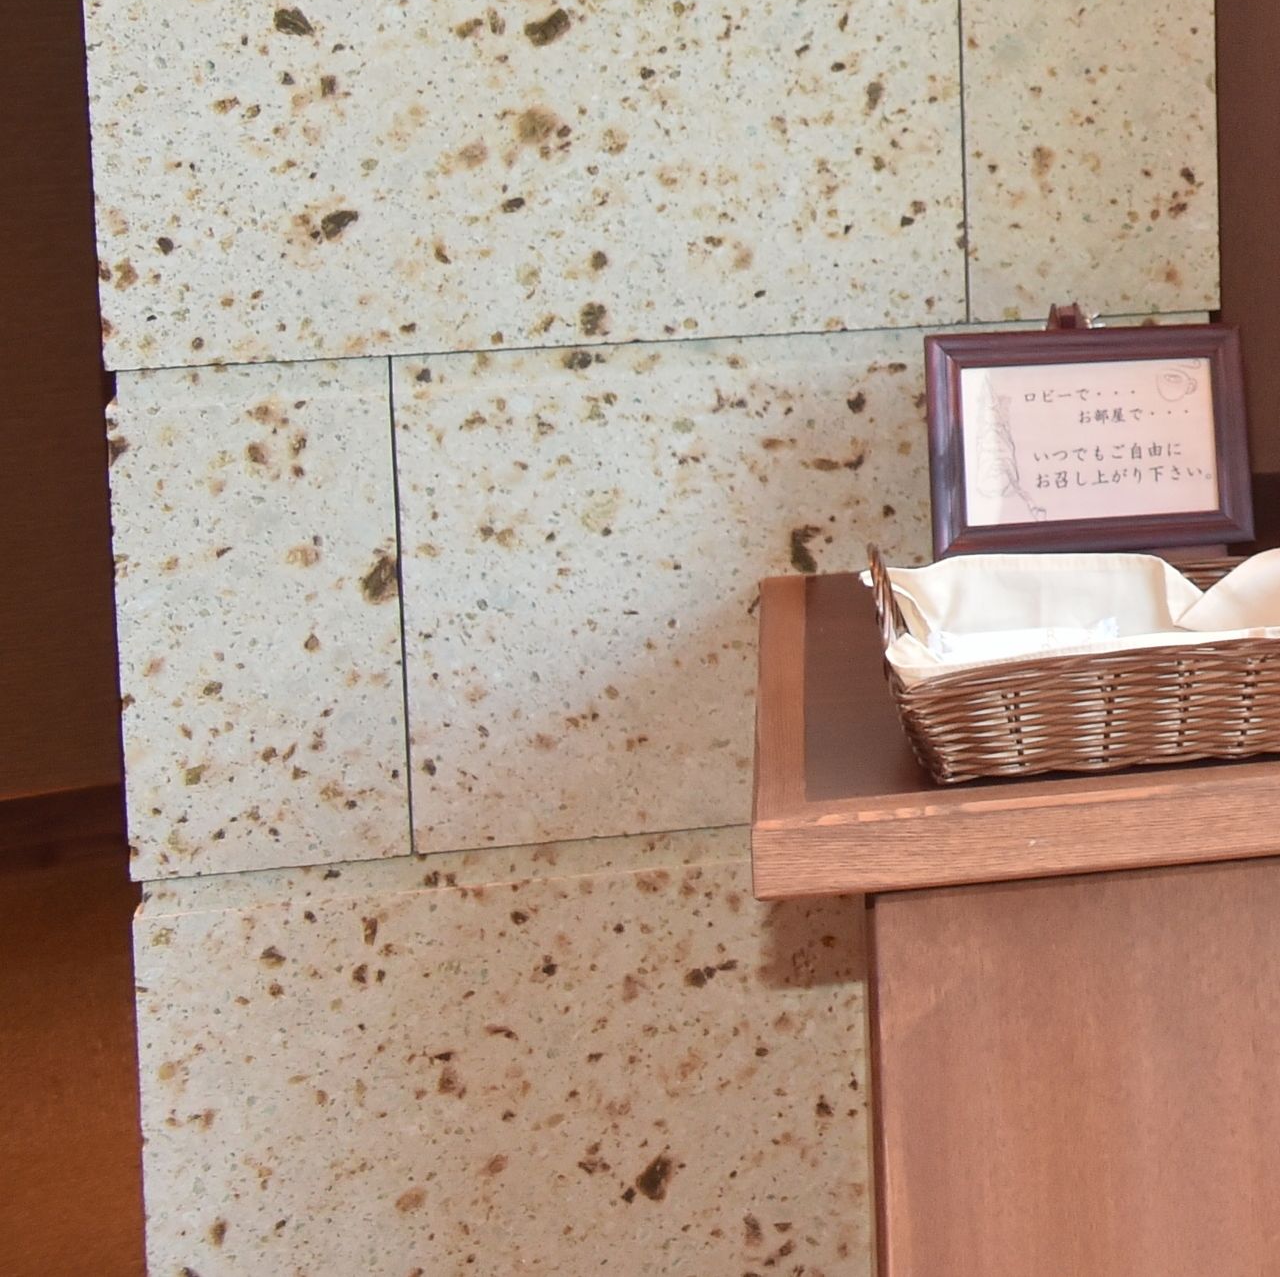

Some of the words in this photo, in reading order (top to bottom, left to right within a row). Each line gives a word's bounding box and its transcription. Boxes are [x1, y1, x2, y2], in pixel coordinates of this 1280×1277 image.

[1033, 441, 1182, 463] いつでもご自由に
[1036, 466, 1213, 488] お召し上がり下さい。
